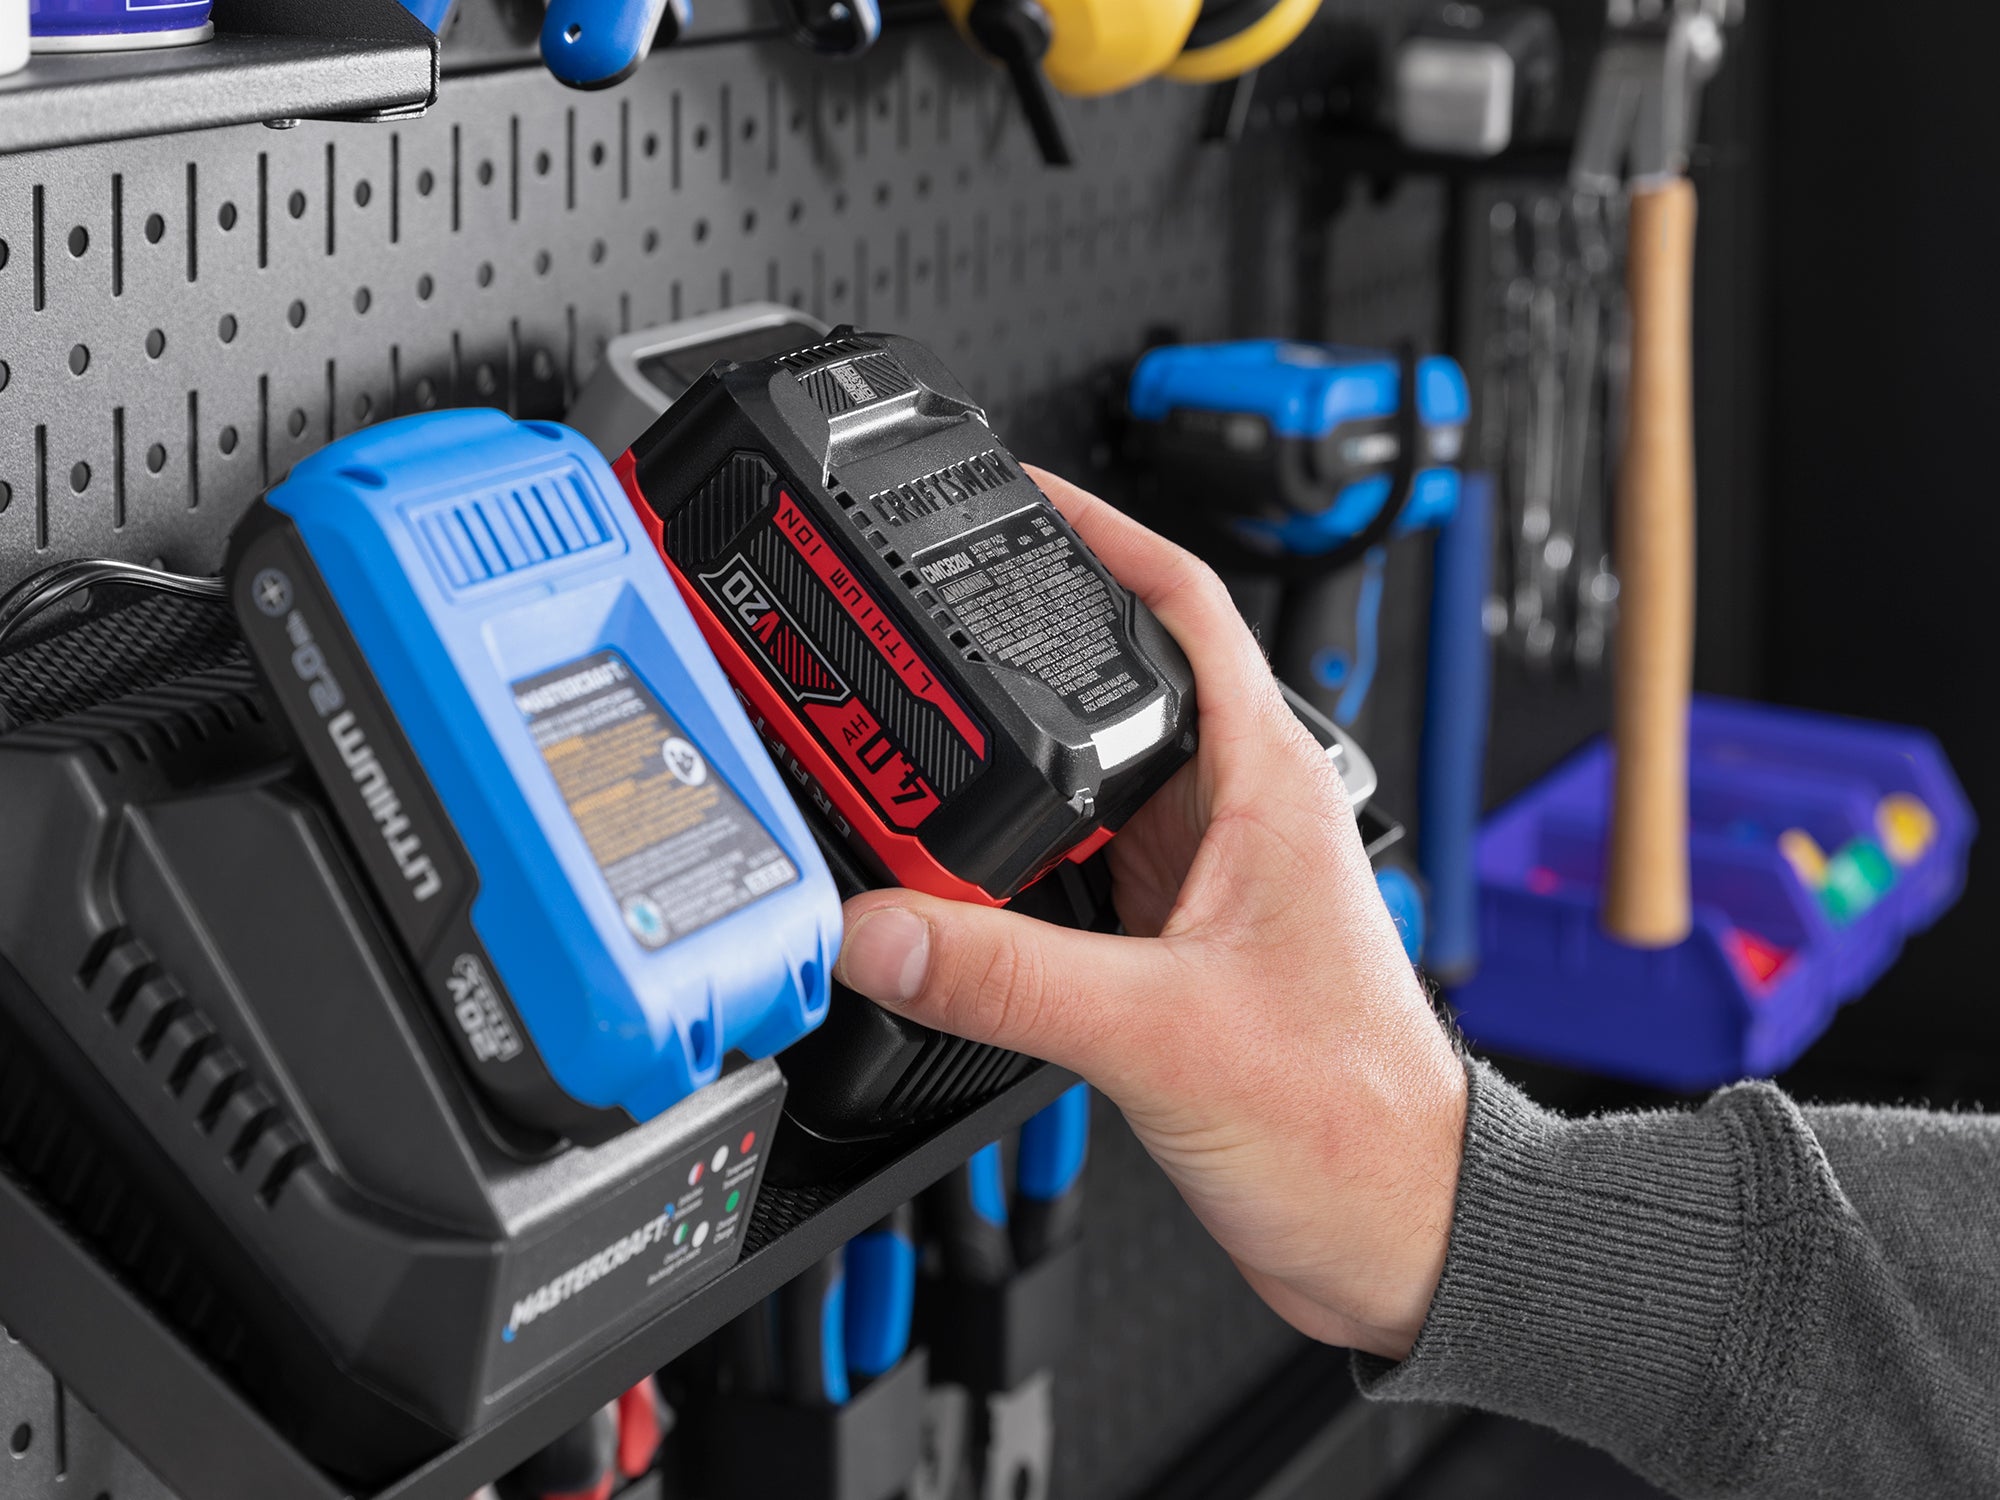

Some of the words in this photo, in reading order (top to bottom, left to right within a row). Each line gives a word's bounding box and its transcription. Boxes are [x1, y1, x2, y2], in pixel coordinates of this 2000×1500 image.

[869, 449, 1017, 528] CRAFTSMAN
[781, 508, 822, 556] ION
[969, 539, 994, 554] BATTERY
[990, 533, 1007, 545] PACK
[1031, 517, 1047, 528] TYPE
[1043, 516, 1050, 524] 1
[919, 550, 975, 584] CMCB204
[986, 567, 997, 577] TO
[994, 560, 1015, 573] REDUCE
[1011, 556, 1024, 566] THE
[1021, 551, 1035, 562] RISK
[1031, 548, 1041, 557] OF
[1054, 536, 1070, 547] USER
[994, 573, 1012, 585] MUST
[1008, 568, 1024, 579] READ
[1020, 555, 1053, 574] INSTRUCTION
[721, 569, 780, 644] V20
[946, 572, 991, 599] WARNING
[953, 605, 967, 616] USE
[962, 600, 980, 612] WITH
[976, 587, 1009, 606] CRAFTSMAN
[1027, 574, 1038, 583] DO
[1034, 569, 1048, 580] NOT
[1044, 562, 1065, 576] CHARGE
[1061, 560, 1070, 568] IF
[968, 619, 993, 634] REDUCIR
[989, 616, 999, 625] EL
[995, 608, 1016, 622] RIESGO
[1012, 605, 1023, 615] DE
[1041, 592, 1051, 601] EL
[1047, 584, 1070, 599] USUARIO
[1083, 571, 1098, 582] LEER
[986, 604, 997, 614] DO
[993, 599, 1008, 610] NOT
[1071, 563, 1088, 575] PARA
[830, 568, 933, 694] LITHIUM
[976, 635, 986, 644] EL
[982, 625, 1006, 641] MANUAL
[1002, 622, 1013, 631] DE
[1045, 597, 1068, 612] UTILIZAR
[1064, 592, 1077, 603] CON
[1074, 590, 1083, 599] EL
[1079, 579, 1106, 596] CARGADOR
[1013, 629, 1025, 639] NO
[1021, 621, 1043, 635] CARGAR
[1040, 618, 1048, 627] SI
[1044, 612, 1062, 625] TIENE
[1075, 601, 1086, 611] NO
[1045, 625, 1062, 637] POUR
[1076, 611, 1092, 622] TOUT
[1088, 603, 1107, 617] RISQUE
[1104, 600, 1114, 609] DE
[1011, 647, 1042, 666] DOMMAGES
[1094, 615, 1108, 627] DOIT
[1104, 611, 1117, 622] LIRE
[1026, 663, 1036, 672] LE
[1032, 653, 1056, 669] MANUEL
[1051, 650, 1062, 660] DE
[1090, 626, 1112, 641] UTILISER
[1038, 667, 1054, 679] AVEC
[1050, 664, 1060, 673] LE
[1056, 652, 1084, 670] CHARGEUR
[1107, 636, 1118, 645] NE
[1047, 676, 1061, 687] PAS
[1057, 663, 1087, 683] RECHARGER
[1083, 661, 1092, 670] SI
[1056, 686, 1068, 696] NE
[1064, 682, 1077, 693] PAS
[1077, 691, 1094, 703] CELLS
[1090, 685, 1106, 697] MADE
[1102, 682, 1112, 691] IN
[1107, 671, 1132, 688] MALAYSIA
[1083, 701, 1099, 713] PACK
[1094, 689, 1122, 708] ASSEMBLED
[1118, 686, 1127, 695] IN
[1124, 680, 1140, 692] CHINA
[841, 713, 870, 747] AH
[855, 732, 928, 806] 4.0
[328, 709, 442, 902] LITHIUM
[506, 1210, 669, 1335] MASTERCRAFT
